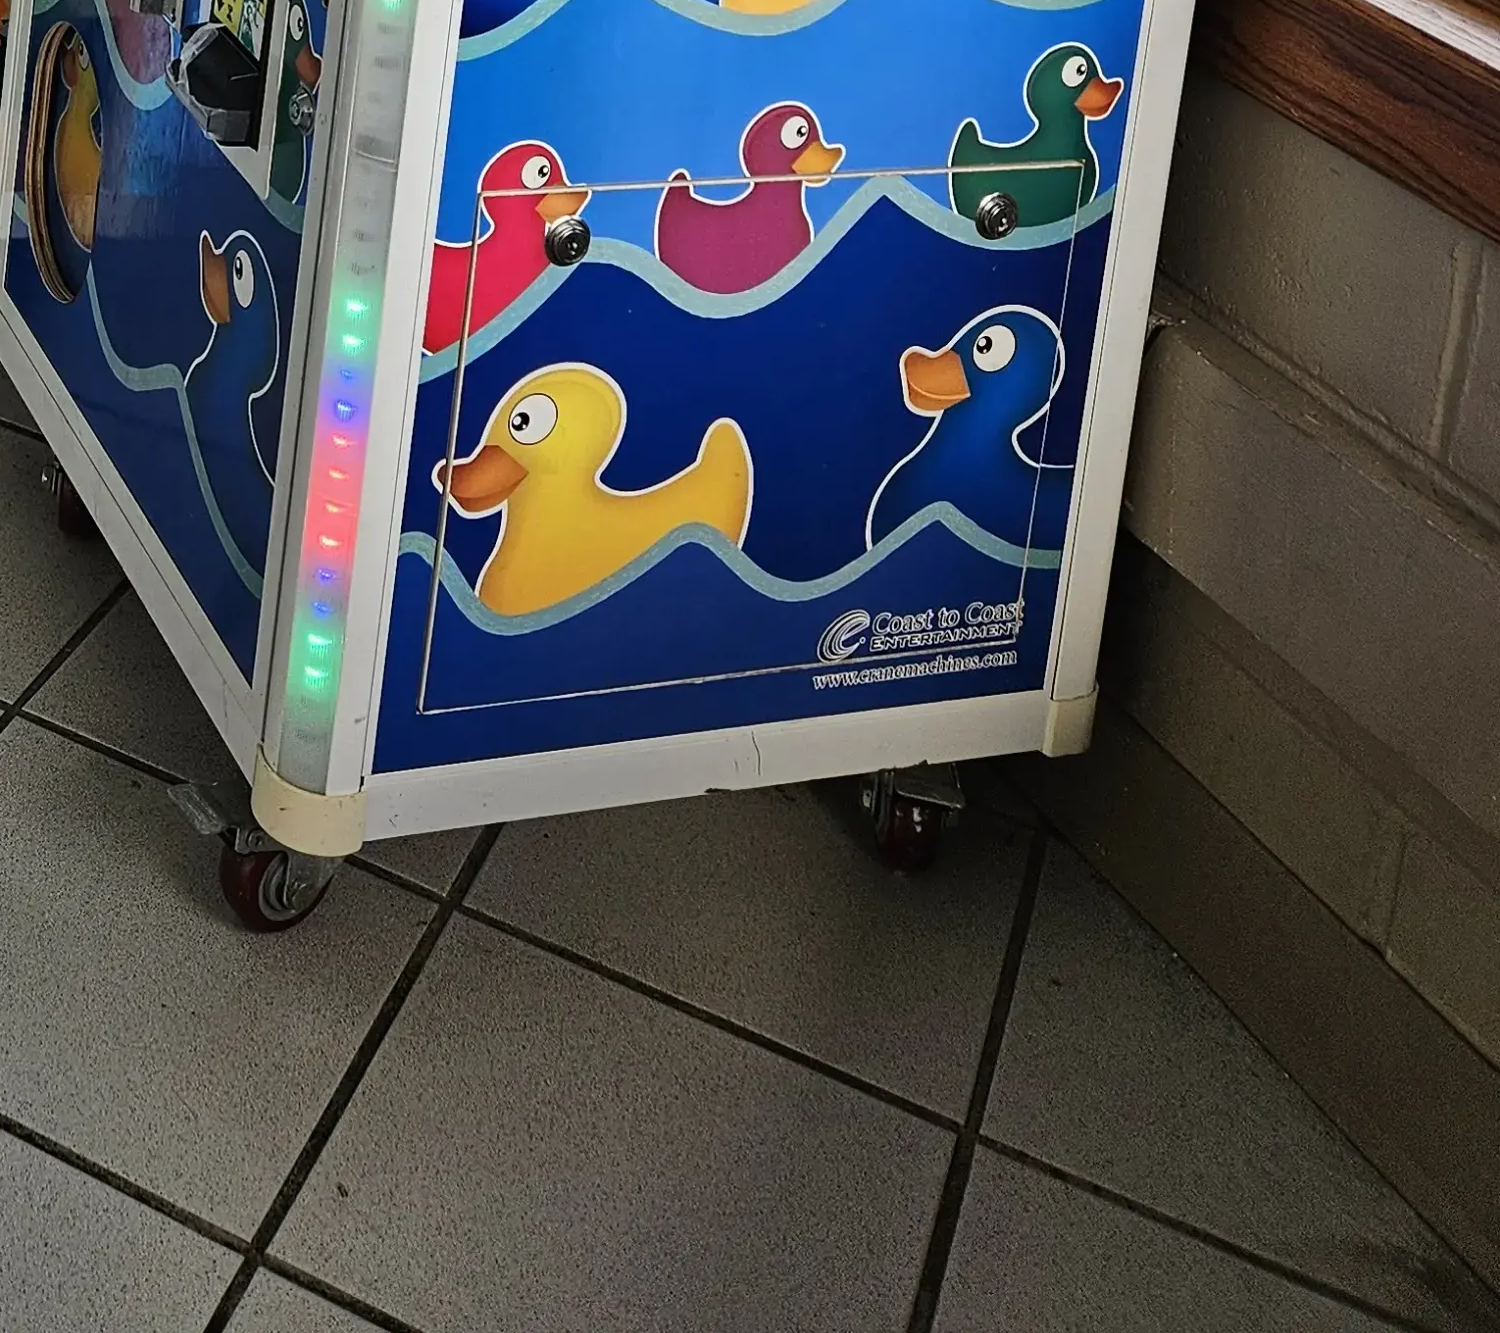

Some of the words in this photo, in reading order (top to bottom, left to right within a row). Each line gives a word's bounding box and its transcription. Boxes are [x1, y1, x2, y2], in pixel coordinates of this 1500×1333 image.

[871, 609, 934, 636] Coast
[938, 606, 961, 627] to
[965, 598, 1025, 626] Coast
[869, 621, 1024, 652] ENTERTAINMENT
[812, 650, 1018, 690] www.cranemachines.com
